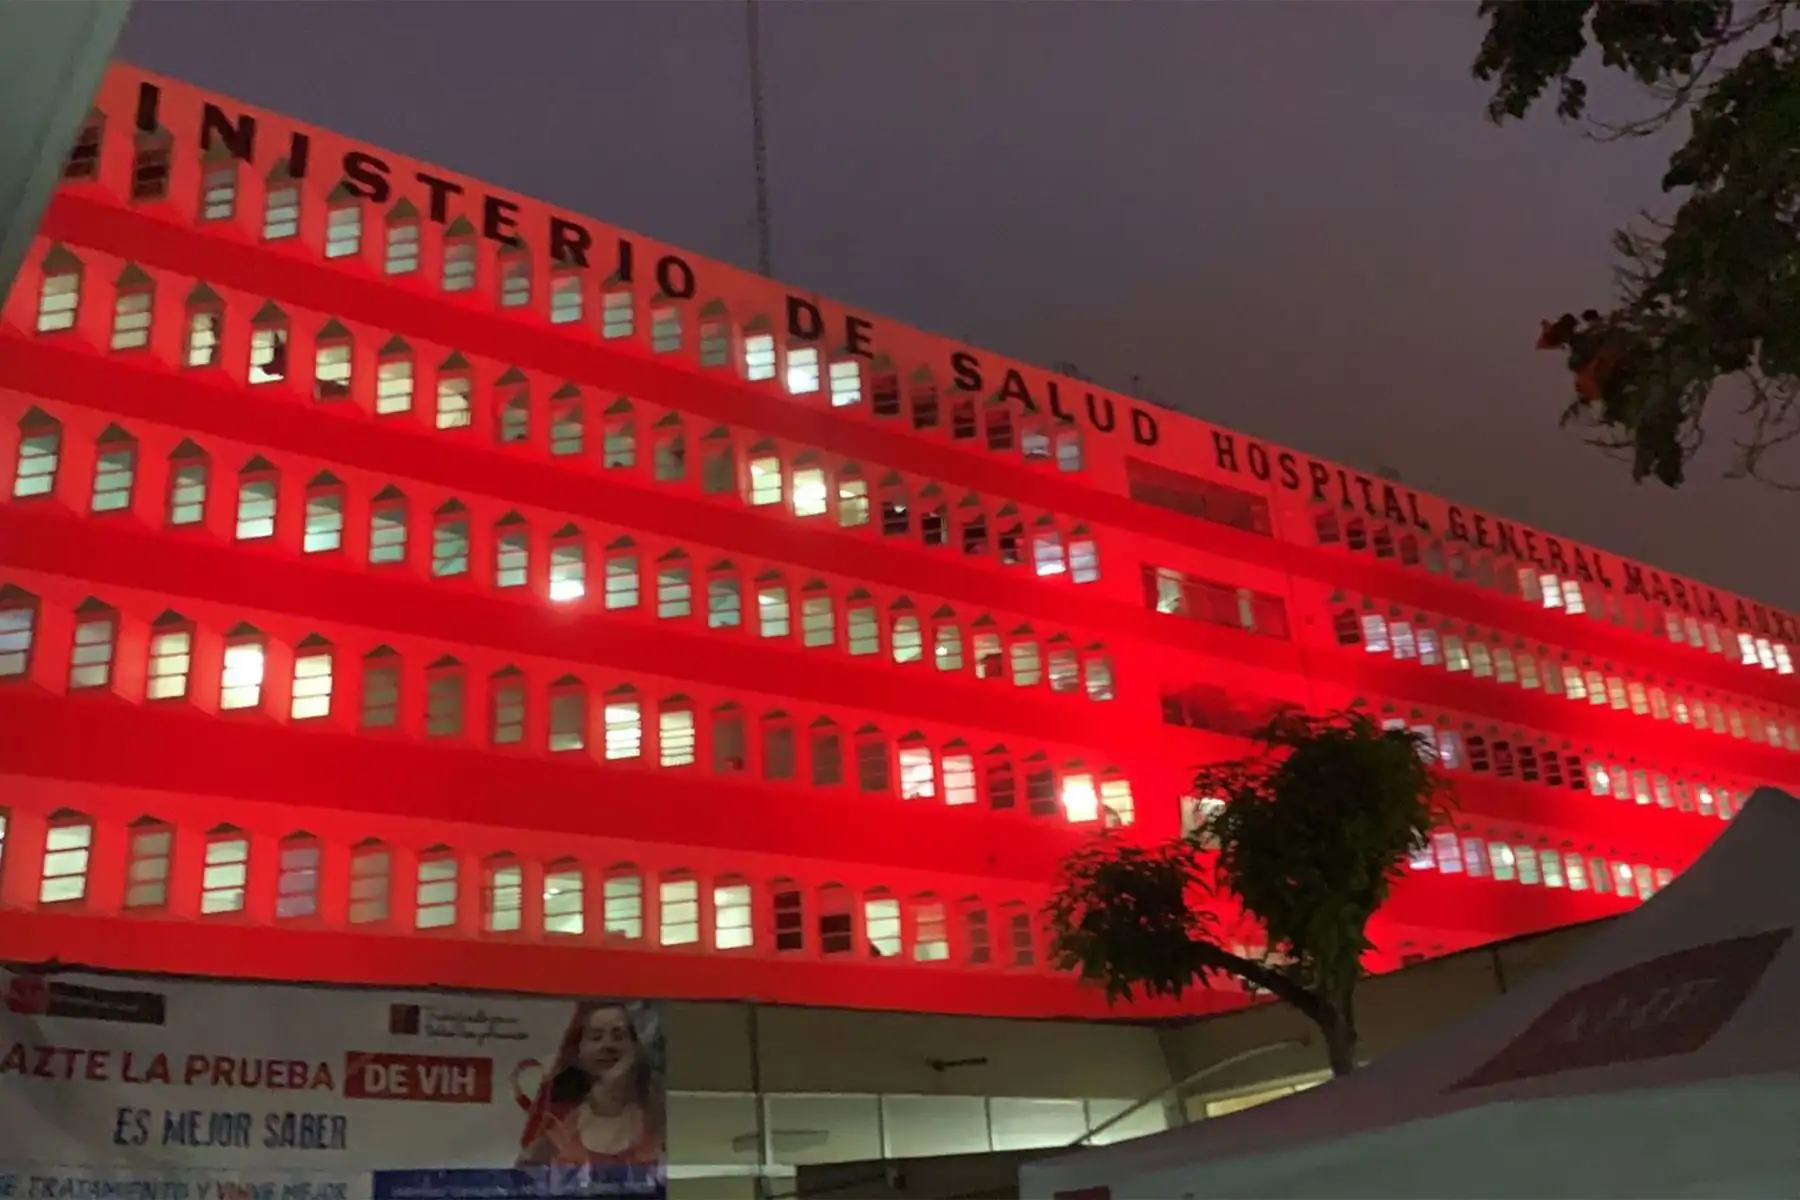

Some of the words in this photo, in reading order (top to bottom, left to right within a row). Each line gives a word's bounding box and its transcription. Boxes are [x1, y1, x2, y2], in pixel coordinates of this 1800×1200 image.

[786, 295, 874, 359] DE
[951, 352, 1158, 446] SALUD
[1211, 431, 1431, 534] HOSPITAL
[1448, 505, 1612, 589] GENERAL
[121, 1051, 171, 1085] LA
[184, 1055, 334, 1091] PRUEBA
[364, 1061, 408, 1094] DE
[417, 1063, 475, 1096] VIH
[113, 1107, 148, 1146] ES
[164, 1109, 252, 1148] MEJOR
[264, 1112, 347, 1150] SABER
